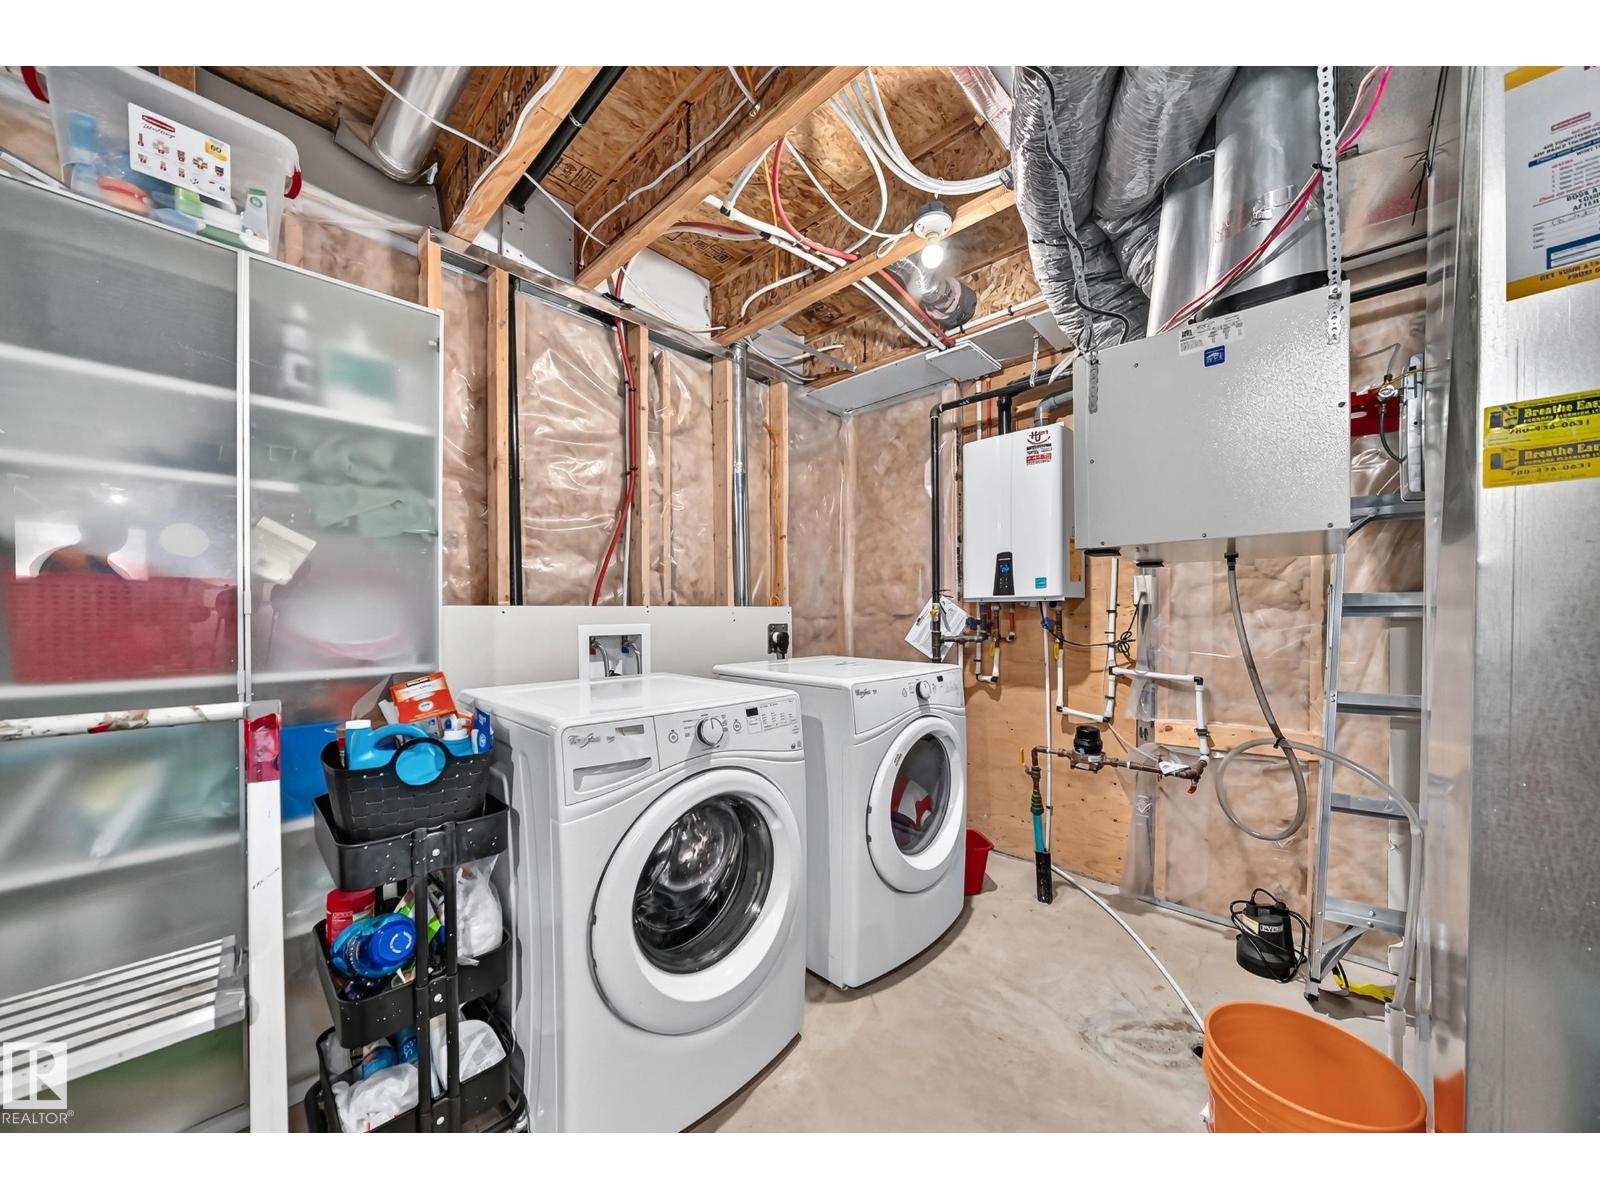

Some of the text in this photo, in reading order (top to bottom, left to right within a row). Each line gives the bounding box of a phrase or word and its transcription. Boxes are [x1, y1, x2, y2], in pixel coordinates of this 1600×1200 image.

[1523, 404, 1573, 418] Breathe
[1576, 399, 1600, 411] Eas
[1523, 446, 1574, 460] Breathe
[1577, 443, 1600, 453] Eas
